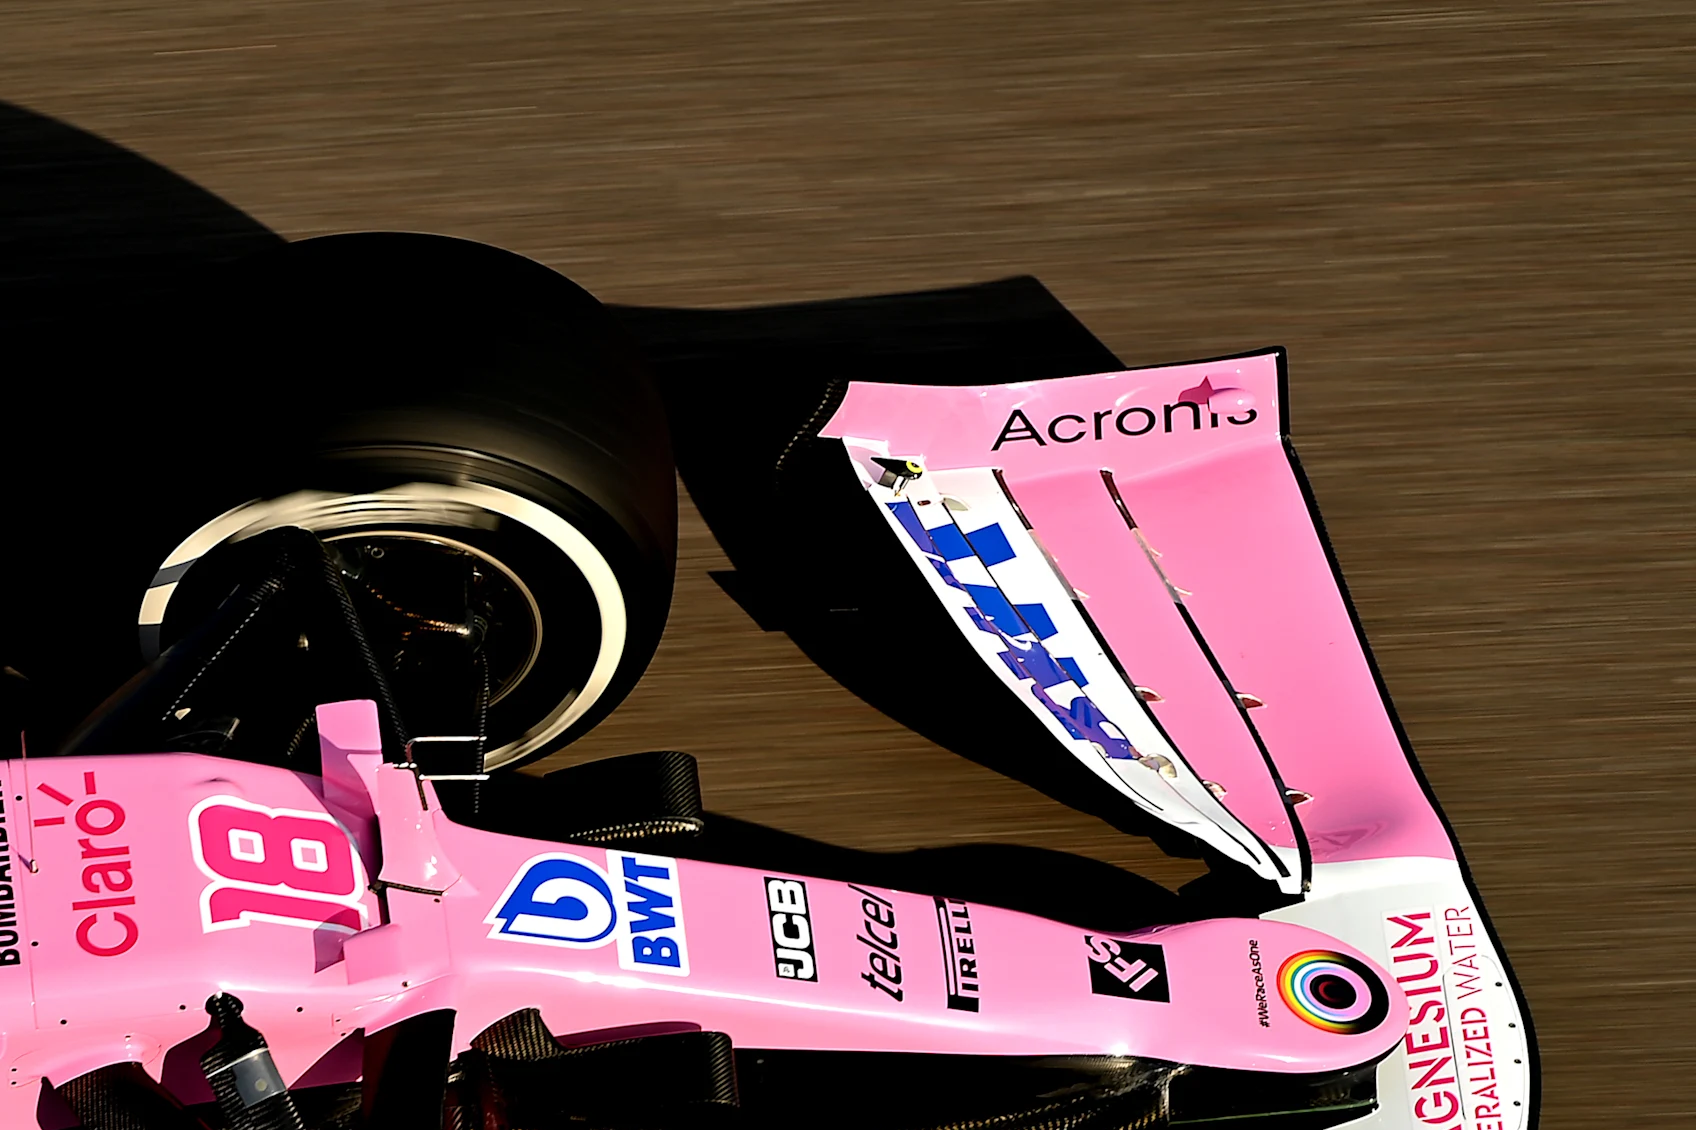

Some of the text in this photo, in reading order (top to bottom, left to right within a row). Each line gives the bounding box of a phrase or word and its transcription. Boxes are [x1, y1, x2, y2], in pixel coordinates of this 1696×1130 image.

[71, 799, 138, 957] Claro
[188, 794, 370, 934] 18
[621, 856, 680, 968] BWT
[768, 879, 814, 979] JCB
[847, 883, 903, 1002] telcel
[933, 895, 979, 1013] PIRELLI
[1087, 937, 1157, 992] IFS
[1249, 940, 1270, 1028] #WeRaceAsOne
[1445, 906, 1482, 1000] WATER
